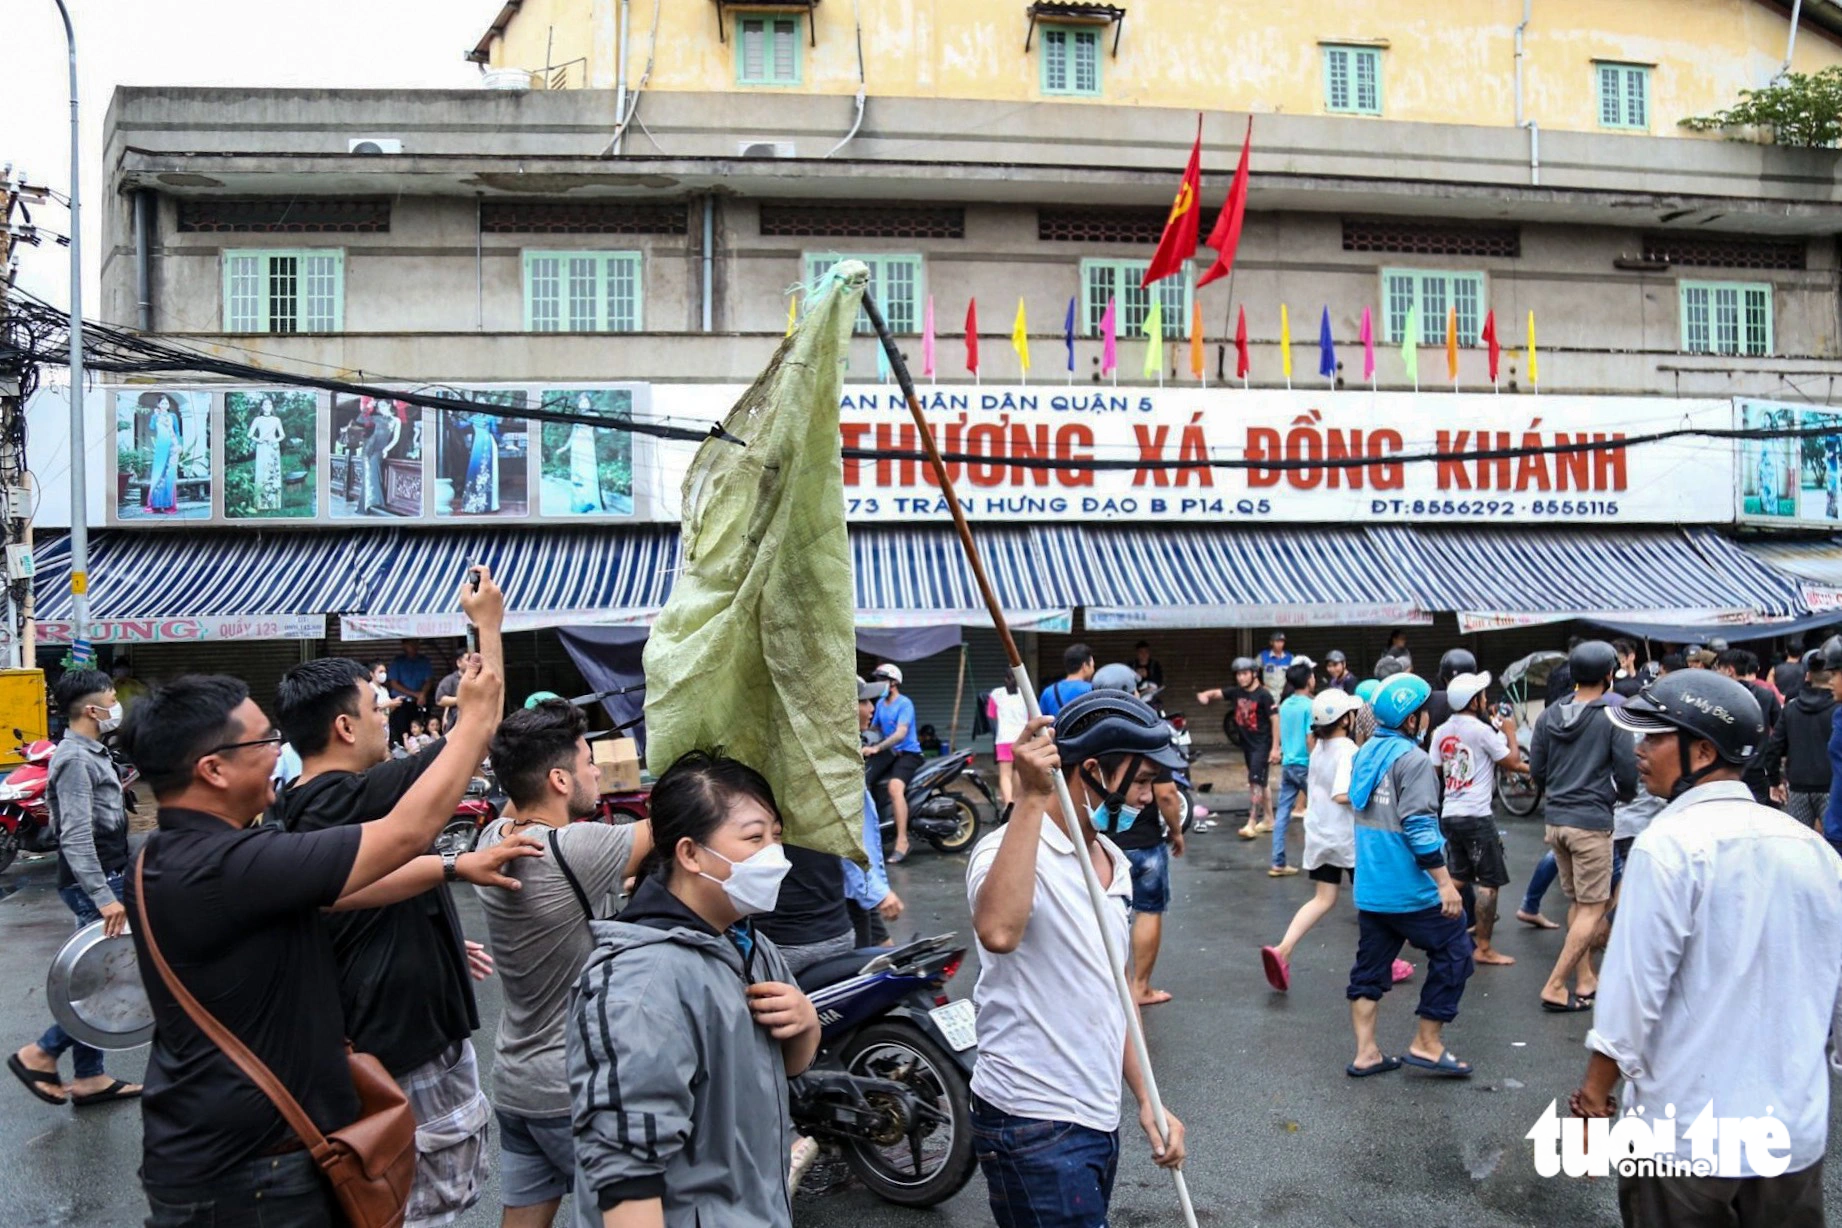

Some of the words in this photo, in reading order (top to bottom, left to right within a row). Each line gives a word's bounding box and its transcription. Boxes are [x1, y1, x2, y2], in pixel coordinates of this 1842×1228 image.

[841, 394, 877, 410] AN
[889, 391, 968, 410] NHÂN
[981, 391, 1038, 410] DÂN
[1050, 392, 1128, 414] QUẬN
[1138, 397, 1153, 411] 5
[839, 411, 1094, 487] THƯƠNG
[1131, 411, 1214, 487] XÁ
[1243, 409, 1404, 491] ĐỒNG
[1435, 417, 1627, 492] KHÁNH
[847, 498, 880, 513] 73
[987, 495, 1067, 513] HƯNG
[1082, 497, 1137, 517] ĐẠO
[1151, 498, 1167, 513] B
[1181, 498, 1271, 514] P14.Q5
[35, 619, 201, 642] RUNG
[1694, 697, 1713, 714] My
